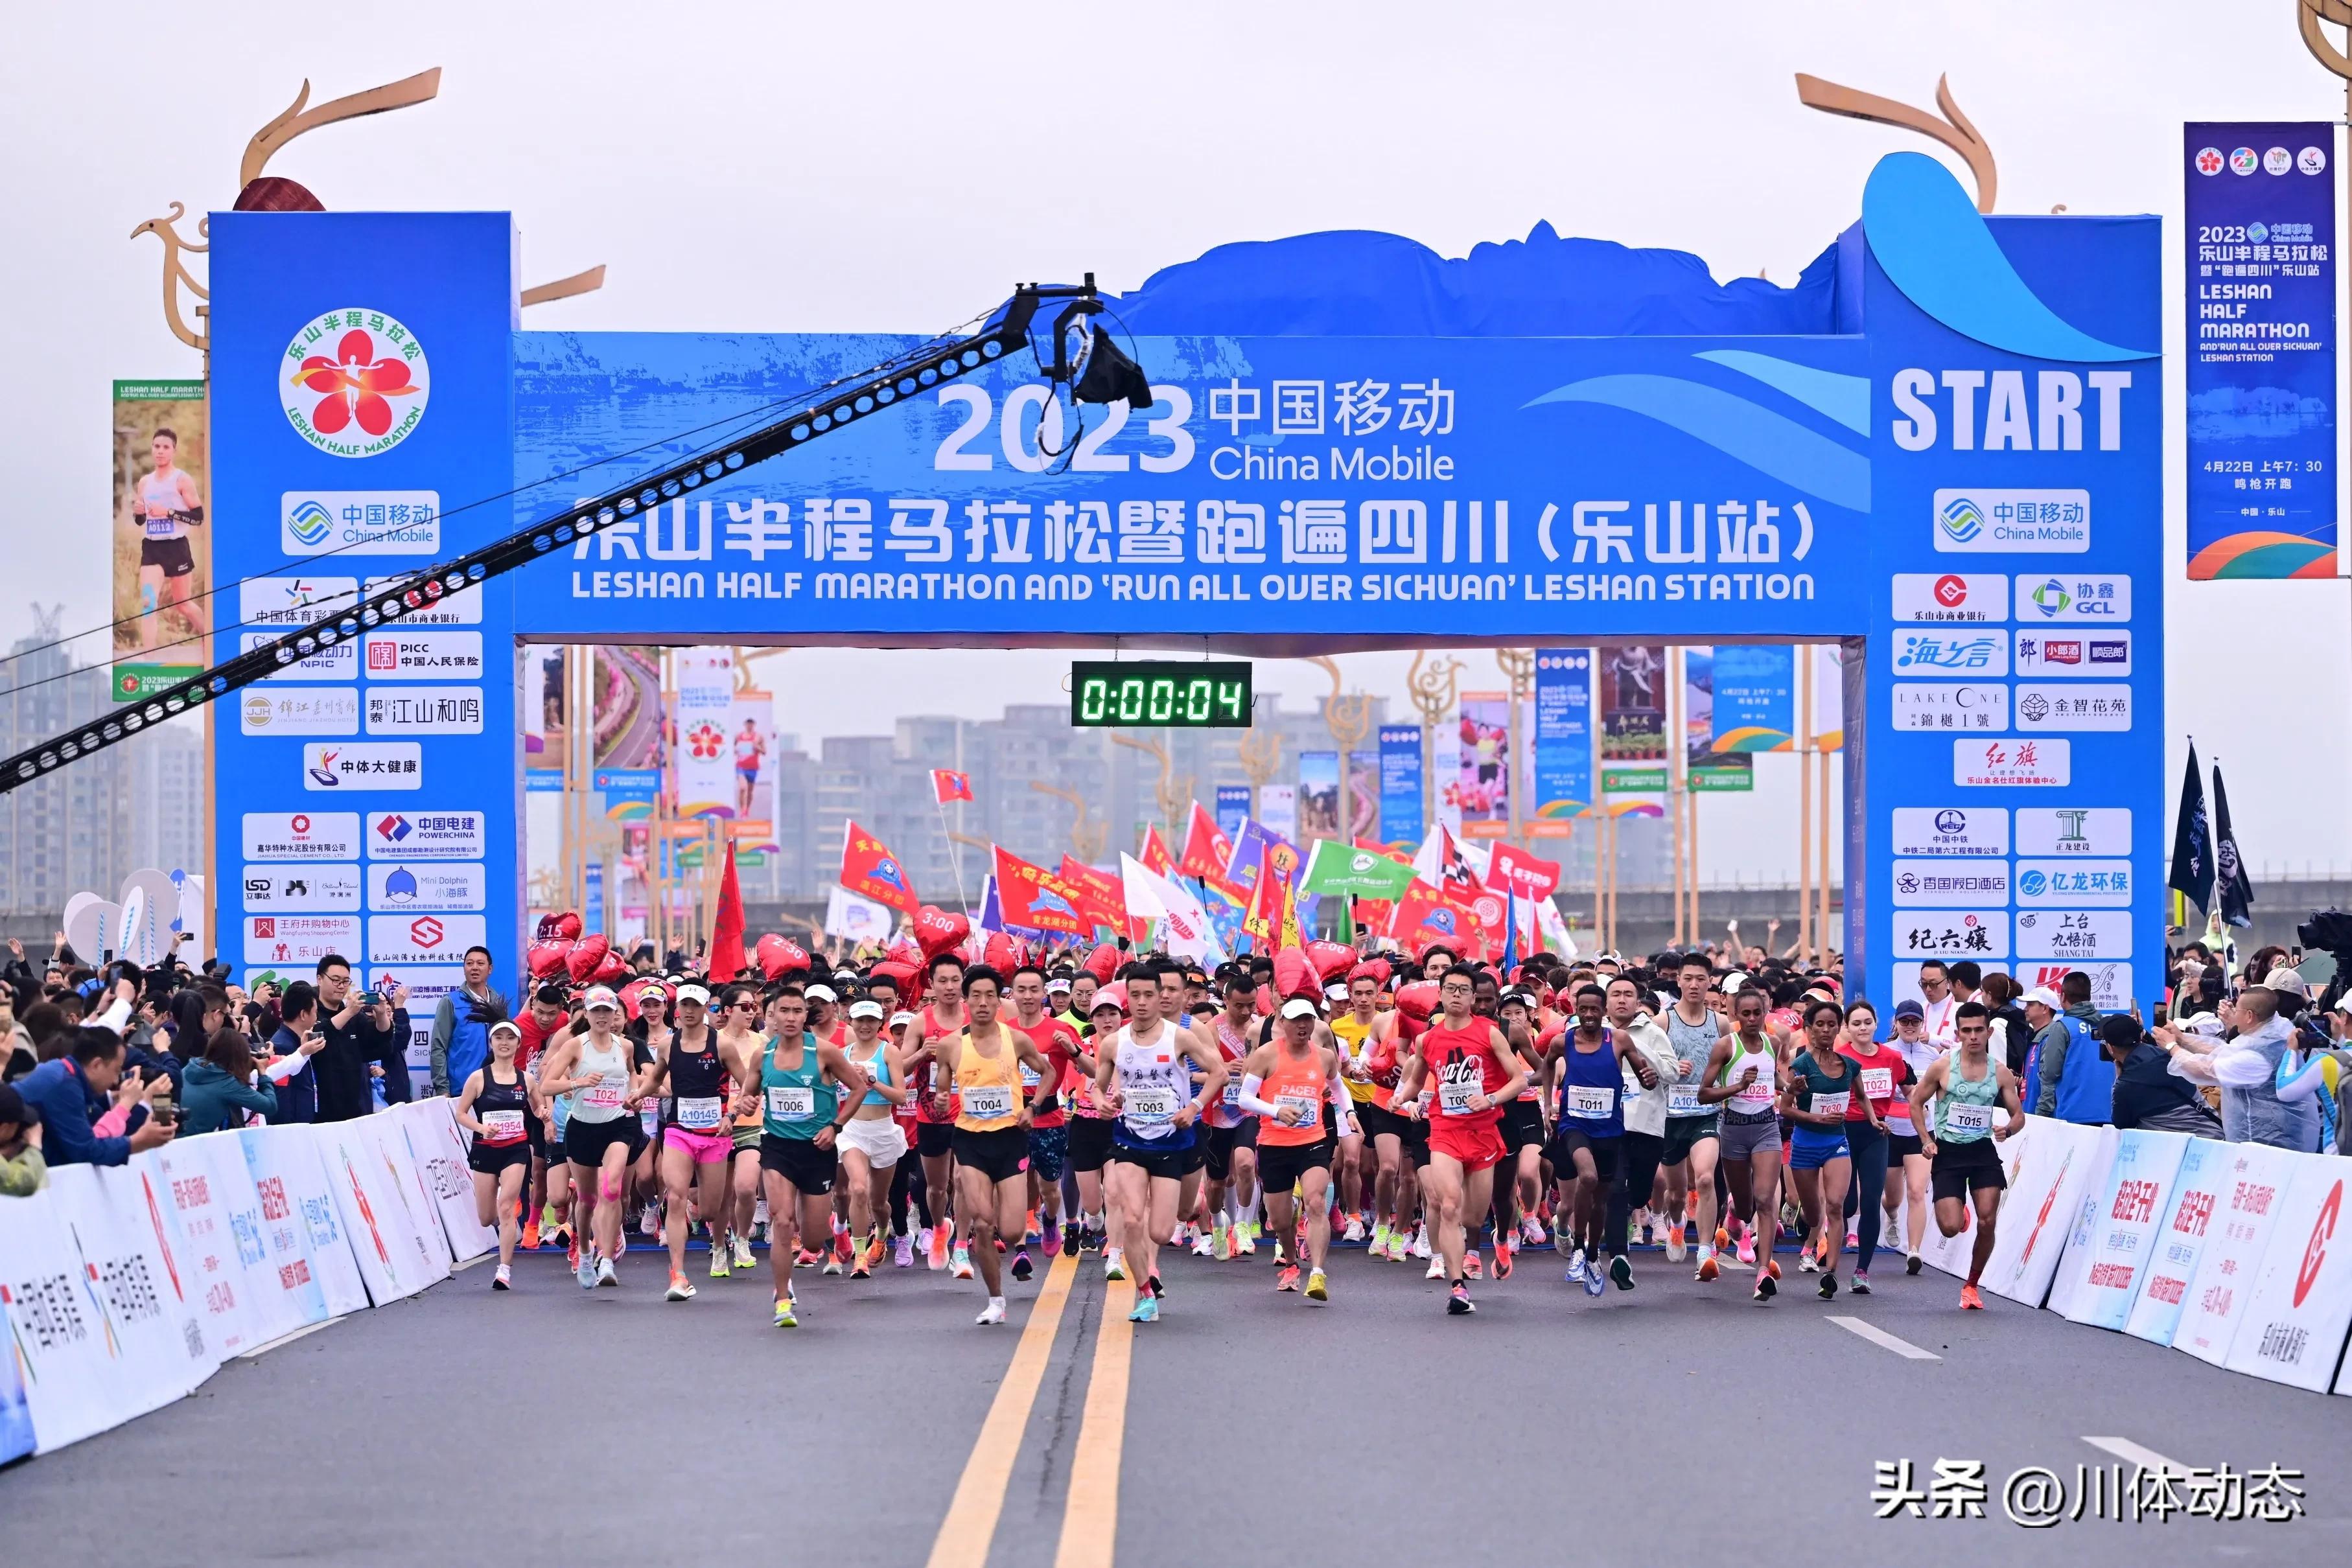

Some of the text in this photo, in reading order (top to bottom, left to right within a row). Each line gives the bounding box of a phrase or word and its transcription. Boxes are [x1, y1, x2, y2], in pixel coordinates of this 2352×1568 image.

[2199, 226, 2246, 243] 2023
[2271, 224, 2313, 235] 中国移动
[2199, 246, 2327, 261] 乐山半程马拉松
[2200, 284, 2272, 299] LESHAN
[2200, 304, 2247, 319] HALF
[288, 311, 421, 362] 乐山半程马拉松
[2200, 323, 2310, 338] MARATHON
[2201, 354, 2274, 362] LESHAN STATION
[1209, 378, 1454, 437] 中国移动
[1892, 367, 2132, 452] START
[288, 406, 421, 455] LESHAN HALF MARATHON
[934, 384, 1196, 474] 2023
[1210, 446, 1454, 481] China Mobile
[2204, 461, 2253, 473] 4月22日
[2235, 478, 2292, 490] 鸣枪开跑
[343, 504, 433, 525] 中国移动
[1994, 502, 2084, 524] 中国移动
[343, 529, 433, 542] China Mobile
[1994, 527, 2084, 540] China Mobile
[573, 572, 705, 599] LESHAN
[717, 572, 802, 599] HALF
[815, 572, 1016, 600] MARATHON
[1025, 573, 1093, 600] AND
[1189, 574, 1253, 601] ALL
[1261, 573, 1352, 601] OVER
[1525, 574, 1656, 601] LESHAN
[1666, 573, 1814, 601] STATION
[2077, 583, 2114, 599] 协鑫
[2076, 603, 2115, 614] GCL
[1914, 611, 1986, 621] 乐山市商业银行
[401, 644, 429, 653] PICC
[1898, 637, 1997, 668] 海之言
[2047, 645, 2079, 656] 小郎酒
[2092, 647, 2124, 658] 顺品郎
[401, 656, 479, 667] 中国人民保险
[1082, 680, 1242, 720] 0:00:04
[1900, 693, 1949, 703] LAKE
[393, 698, 479, 723] 江山和鸣
[2055, 699, 2126, 712] 金智花苑
[1986, 741, 2038, 768] 红旗
[341, 760, 417, 774] 中体大健康
[419, 817, 474, 831] 中国电建
[1933, 835, 1968, 844] 中国中铁
[257, 844, 346, 853] 嘉华特种水泥股份有限公司
[2056, 842, 2090, 851] 正龙建设
[439, 877, 468, 886] Dolphin
[2051, 872, 2128, 891] 亿龙环保
[435, 888, 468, 898] 小海豚
[280, 919, 350, 928] 王府井购物中心
[922, 912, 955, 933] 3:00
[539, 924, 563, 938] 2:15
[1314, 941, 1346, 954] 2:00
[2054, 949, 2094, 958] SHANG TAI
[415, 1031, 428, 1045] 四
[1123, 1068, 1173, 1081] 中国警察
[1281, 1085, 1317, 1095] PACER
[1864, 1079, 1887, 1090] T027
[595, 1090, 617, 1100] T021
[777, 1101, 804, 1111] T006
[973, 1100, 1002, 1111] T004
[1135, 1103, 1164, 1113] T003
[1579, 1099, 1602, 1109] T011
[1821, 1103, 1841, 1113] T030
[682, 1109, 718, 1120] A10145
[1958, 1115, 1982, 1126] T015
